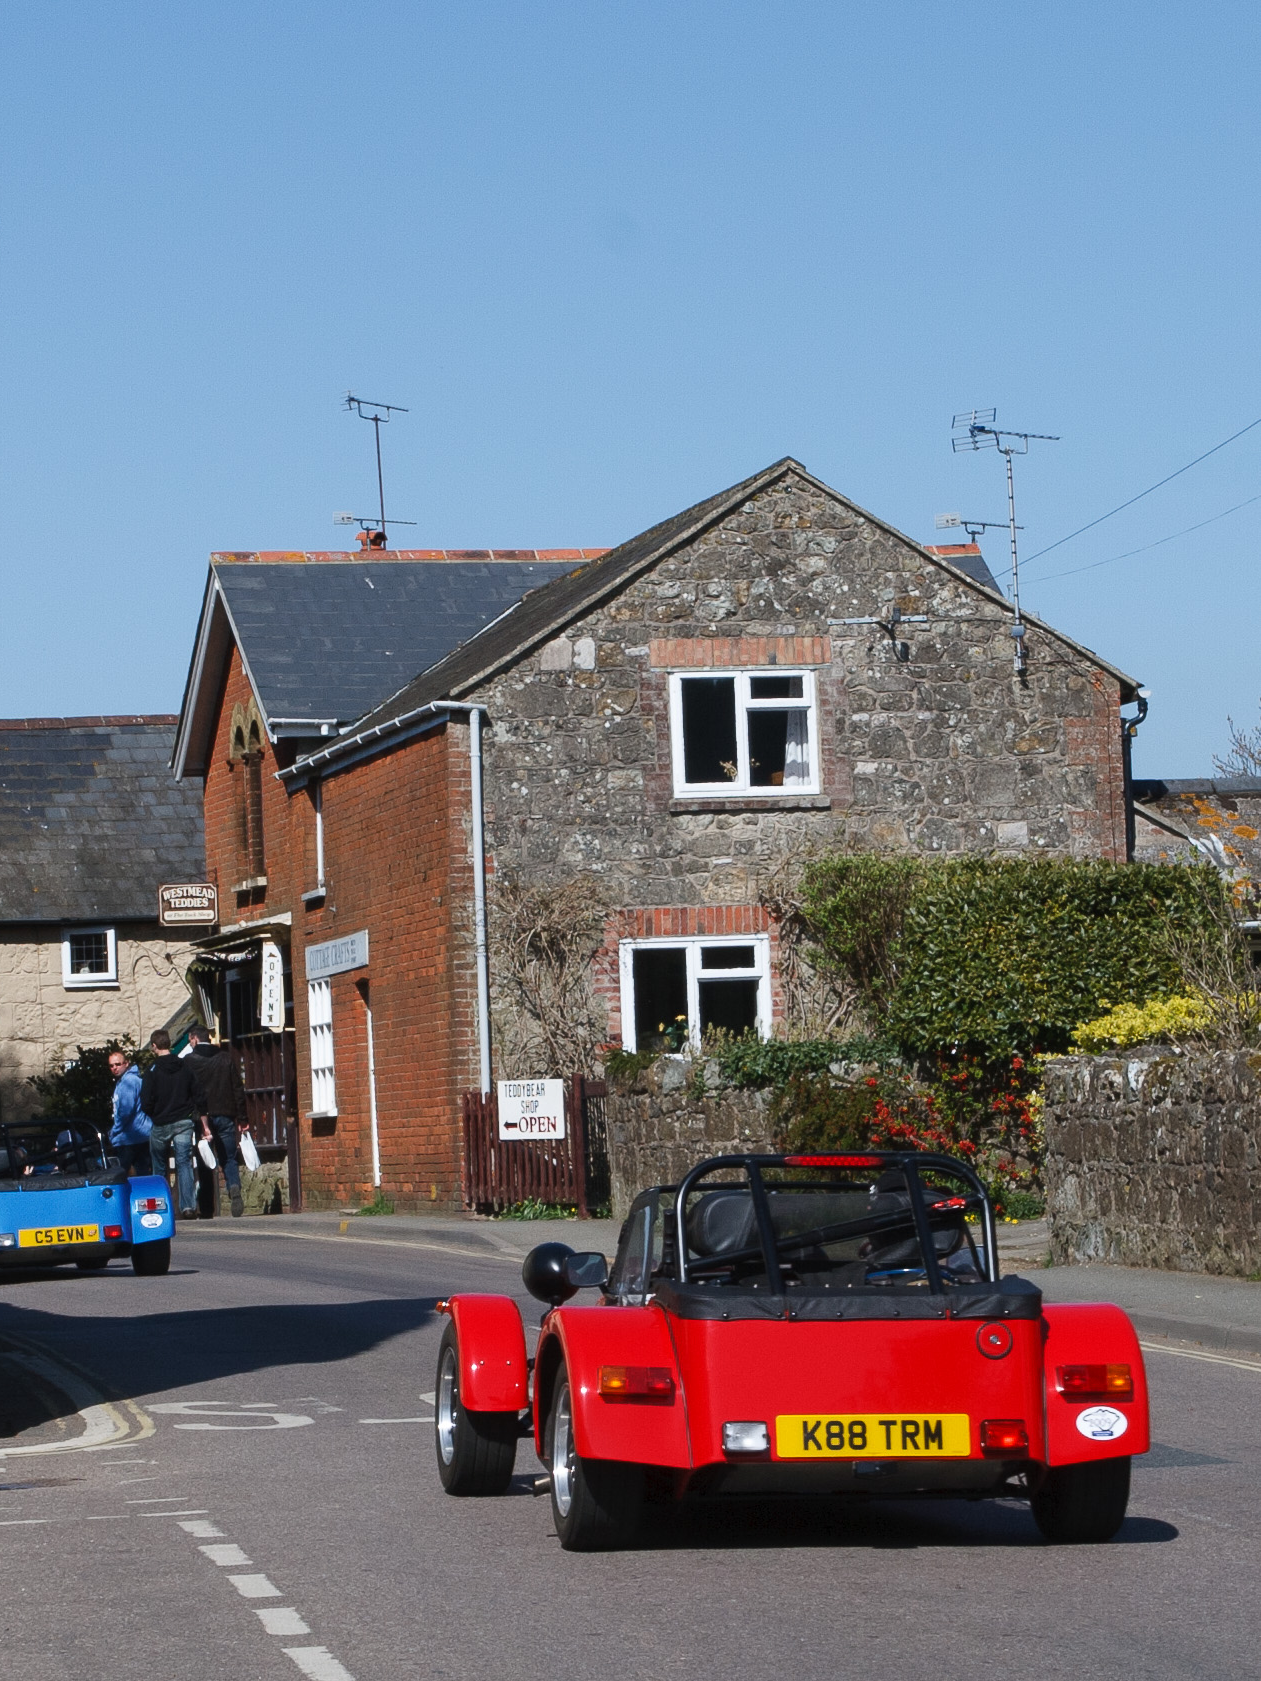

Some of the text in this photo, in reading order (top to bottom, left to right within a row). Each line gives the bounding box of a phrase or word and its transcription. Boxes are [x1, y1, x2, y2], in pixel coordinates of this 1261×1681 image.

[163, 887, 214, 900] WESTMEAD
[169, 898, 209, 908] TEDDIES
[504, 1083, 545, 1097] TEDDYBEAR
[521, 1100, 539, 1113] SHOP
[519, 1116, 557, 1133] OPEN
[35, 1227, 85, 1244] C5 EVN
[802, 1420, 943, 1450] K88 TRM
